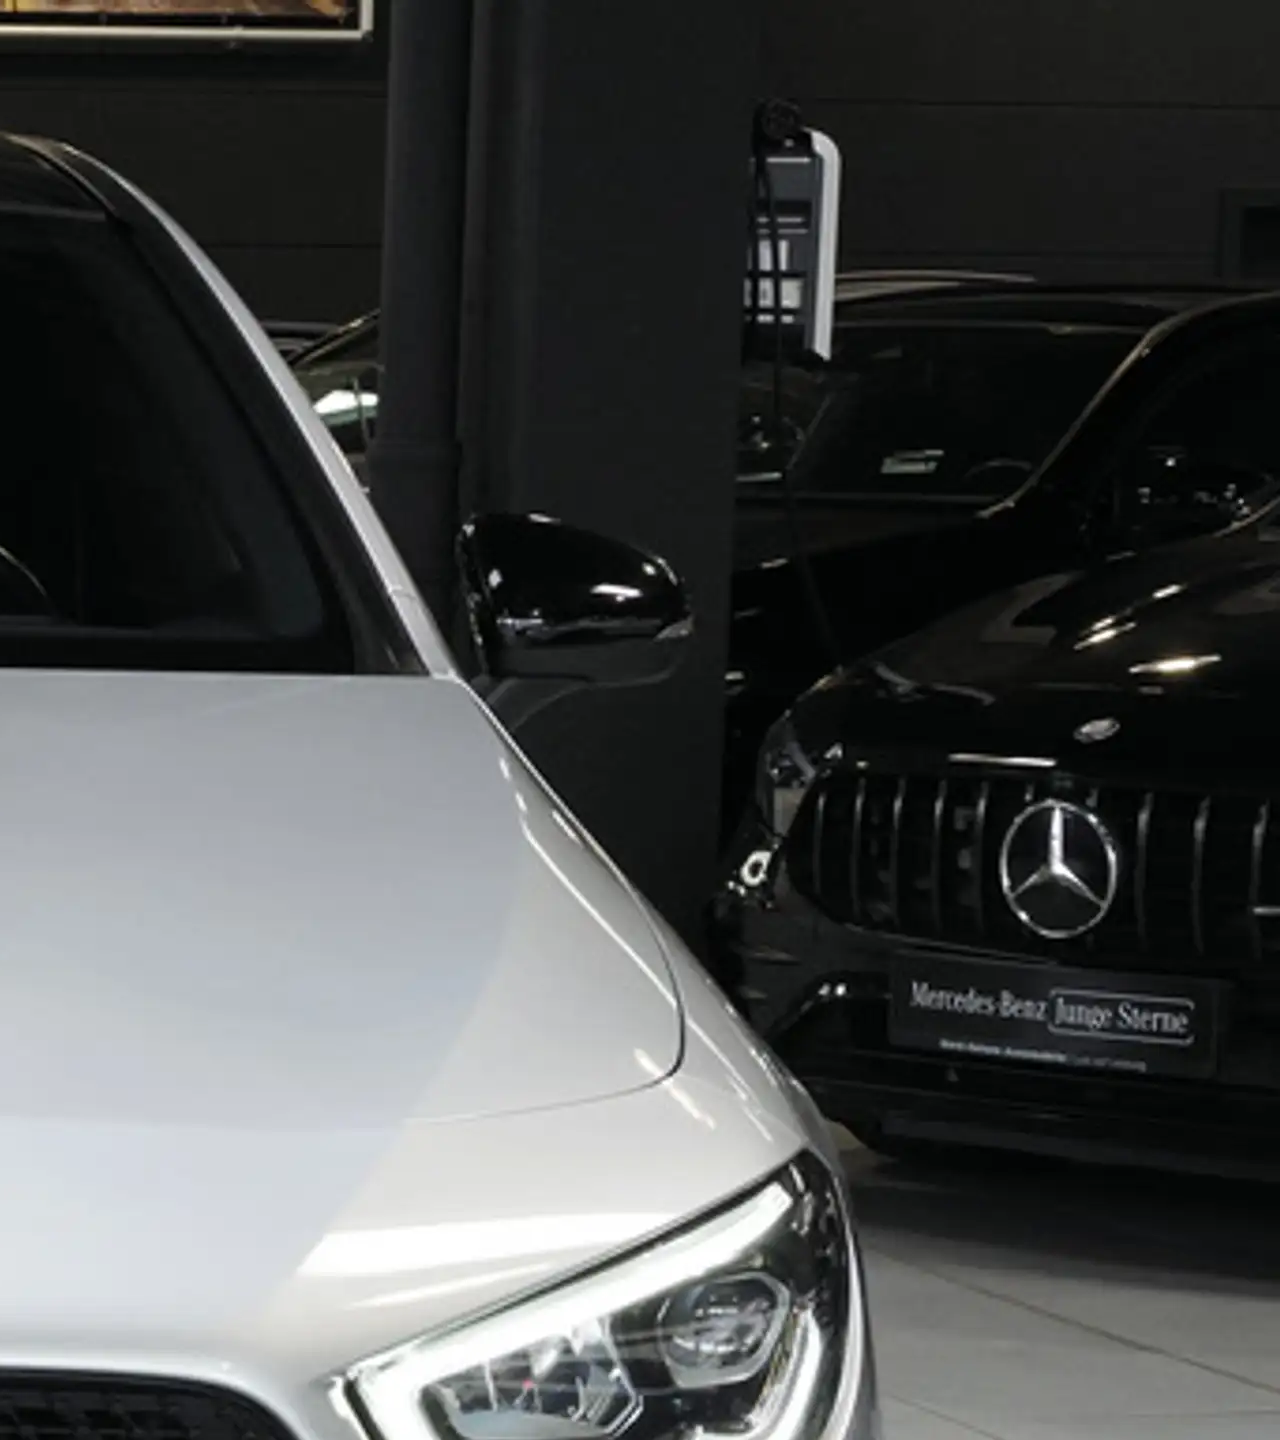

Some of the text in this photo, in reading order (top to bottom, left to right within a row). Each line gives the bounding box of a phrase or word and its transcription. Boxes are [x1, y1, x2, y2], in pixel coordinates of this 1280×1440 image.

[910, 981, 1189, 1033] Mercedes-Benz Junge Sterne
